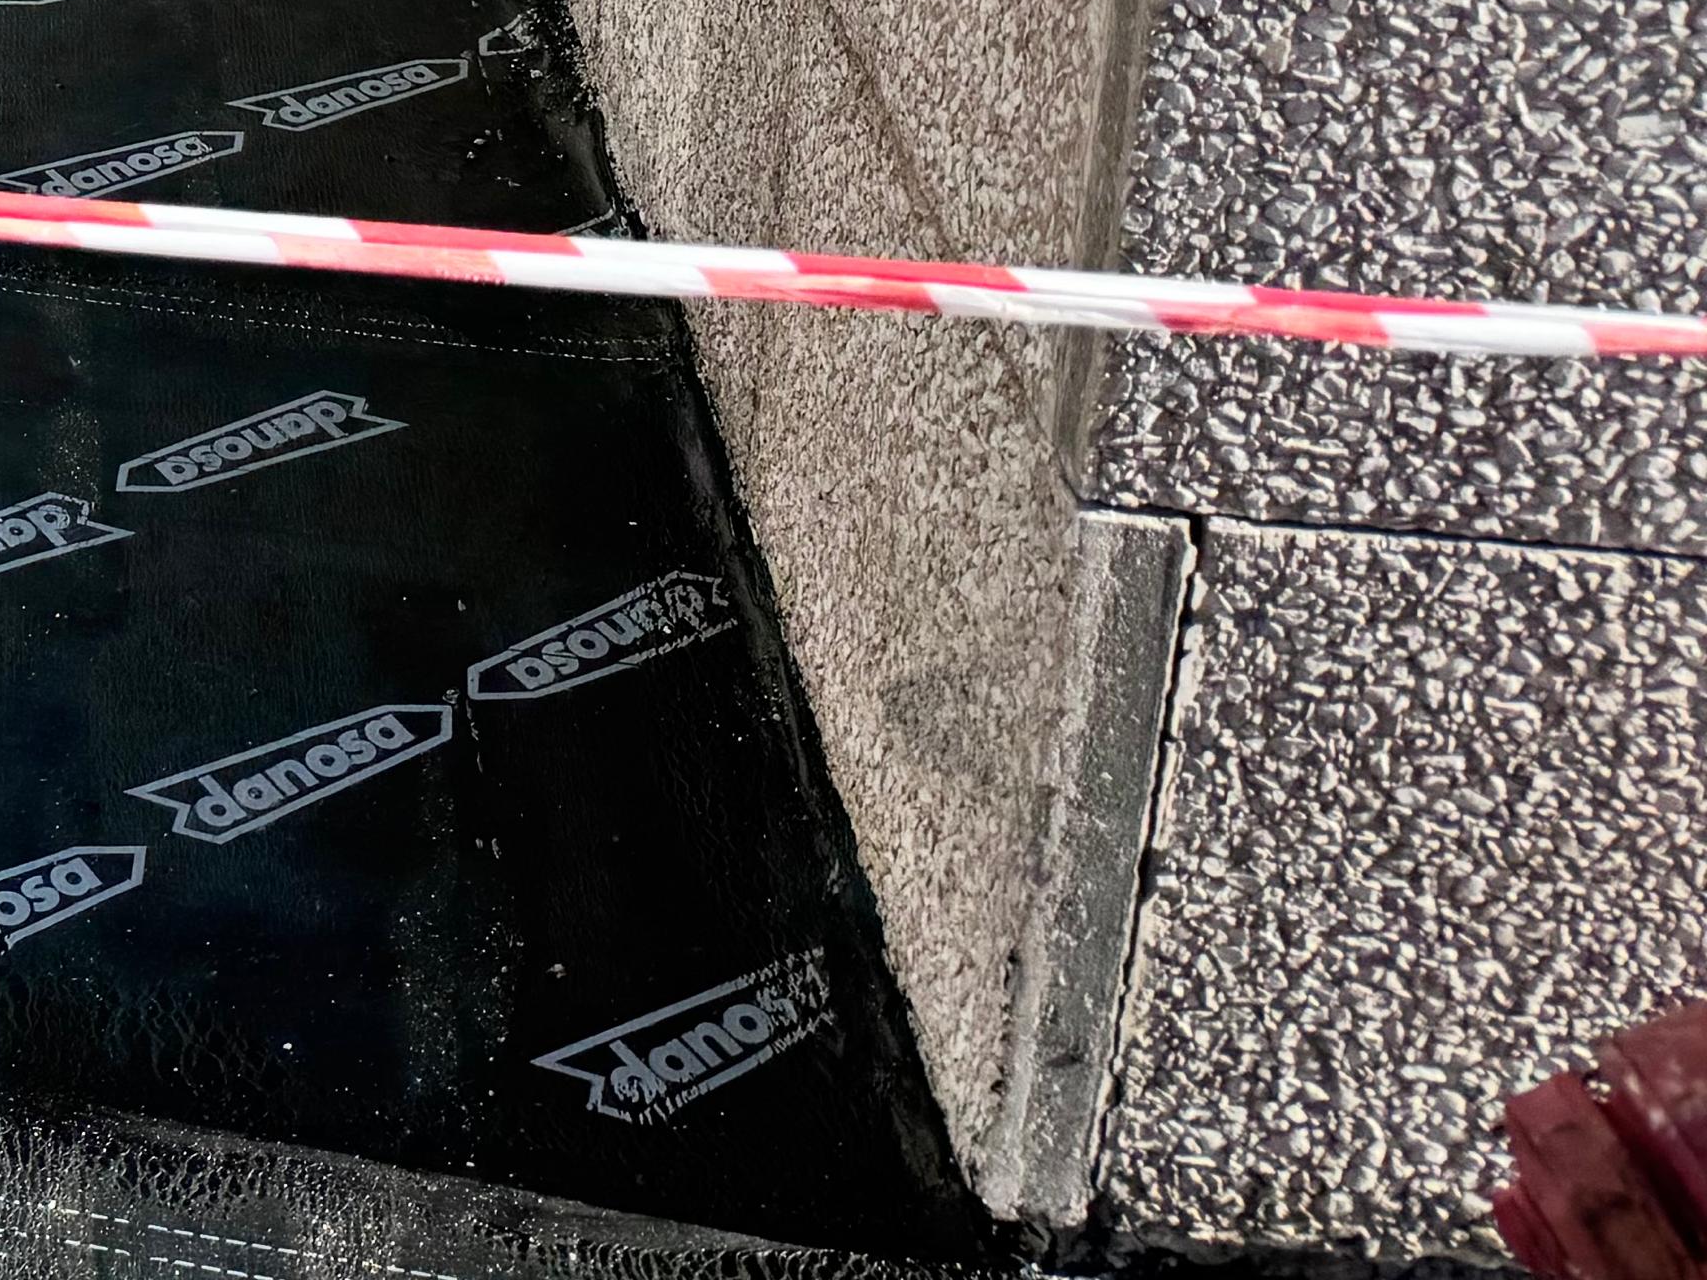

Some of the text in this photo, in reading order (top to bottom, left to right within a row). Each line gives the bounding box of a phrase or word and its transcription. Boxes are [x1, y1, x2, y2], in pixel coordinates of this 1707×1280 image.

[275, 63, 441, 126] danosa
[154, 398, 347, 487] danosa
[192, 712, 417, 835] danosa
